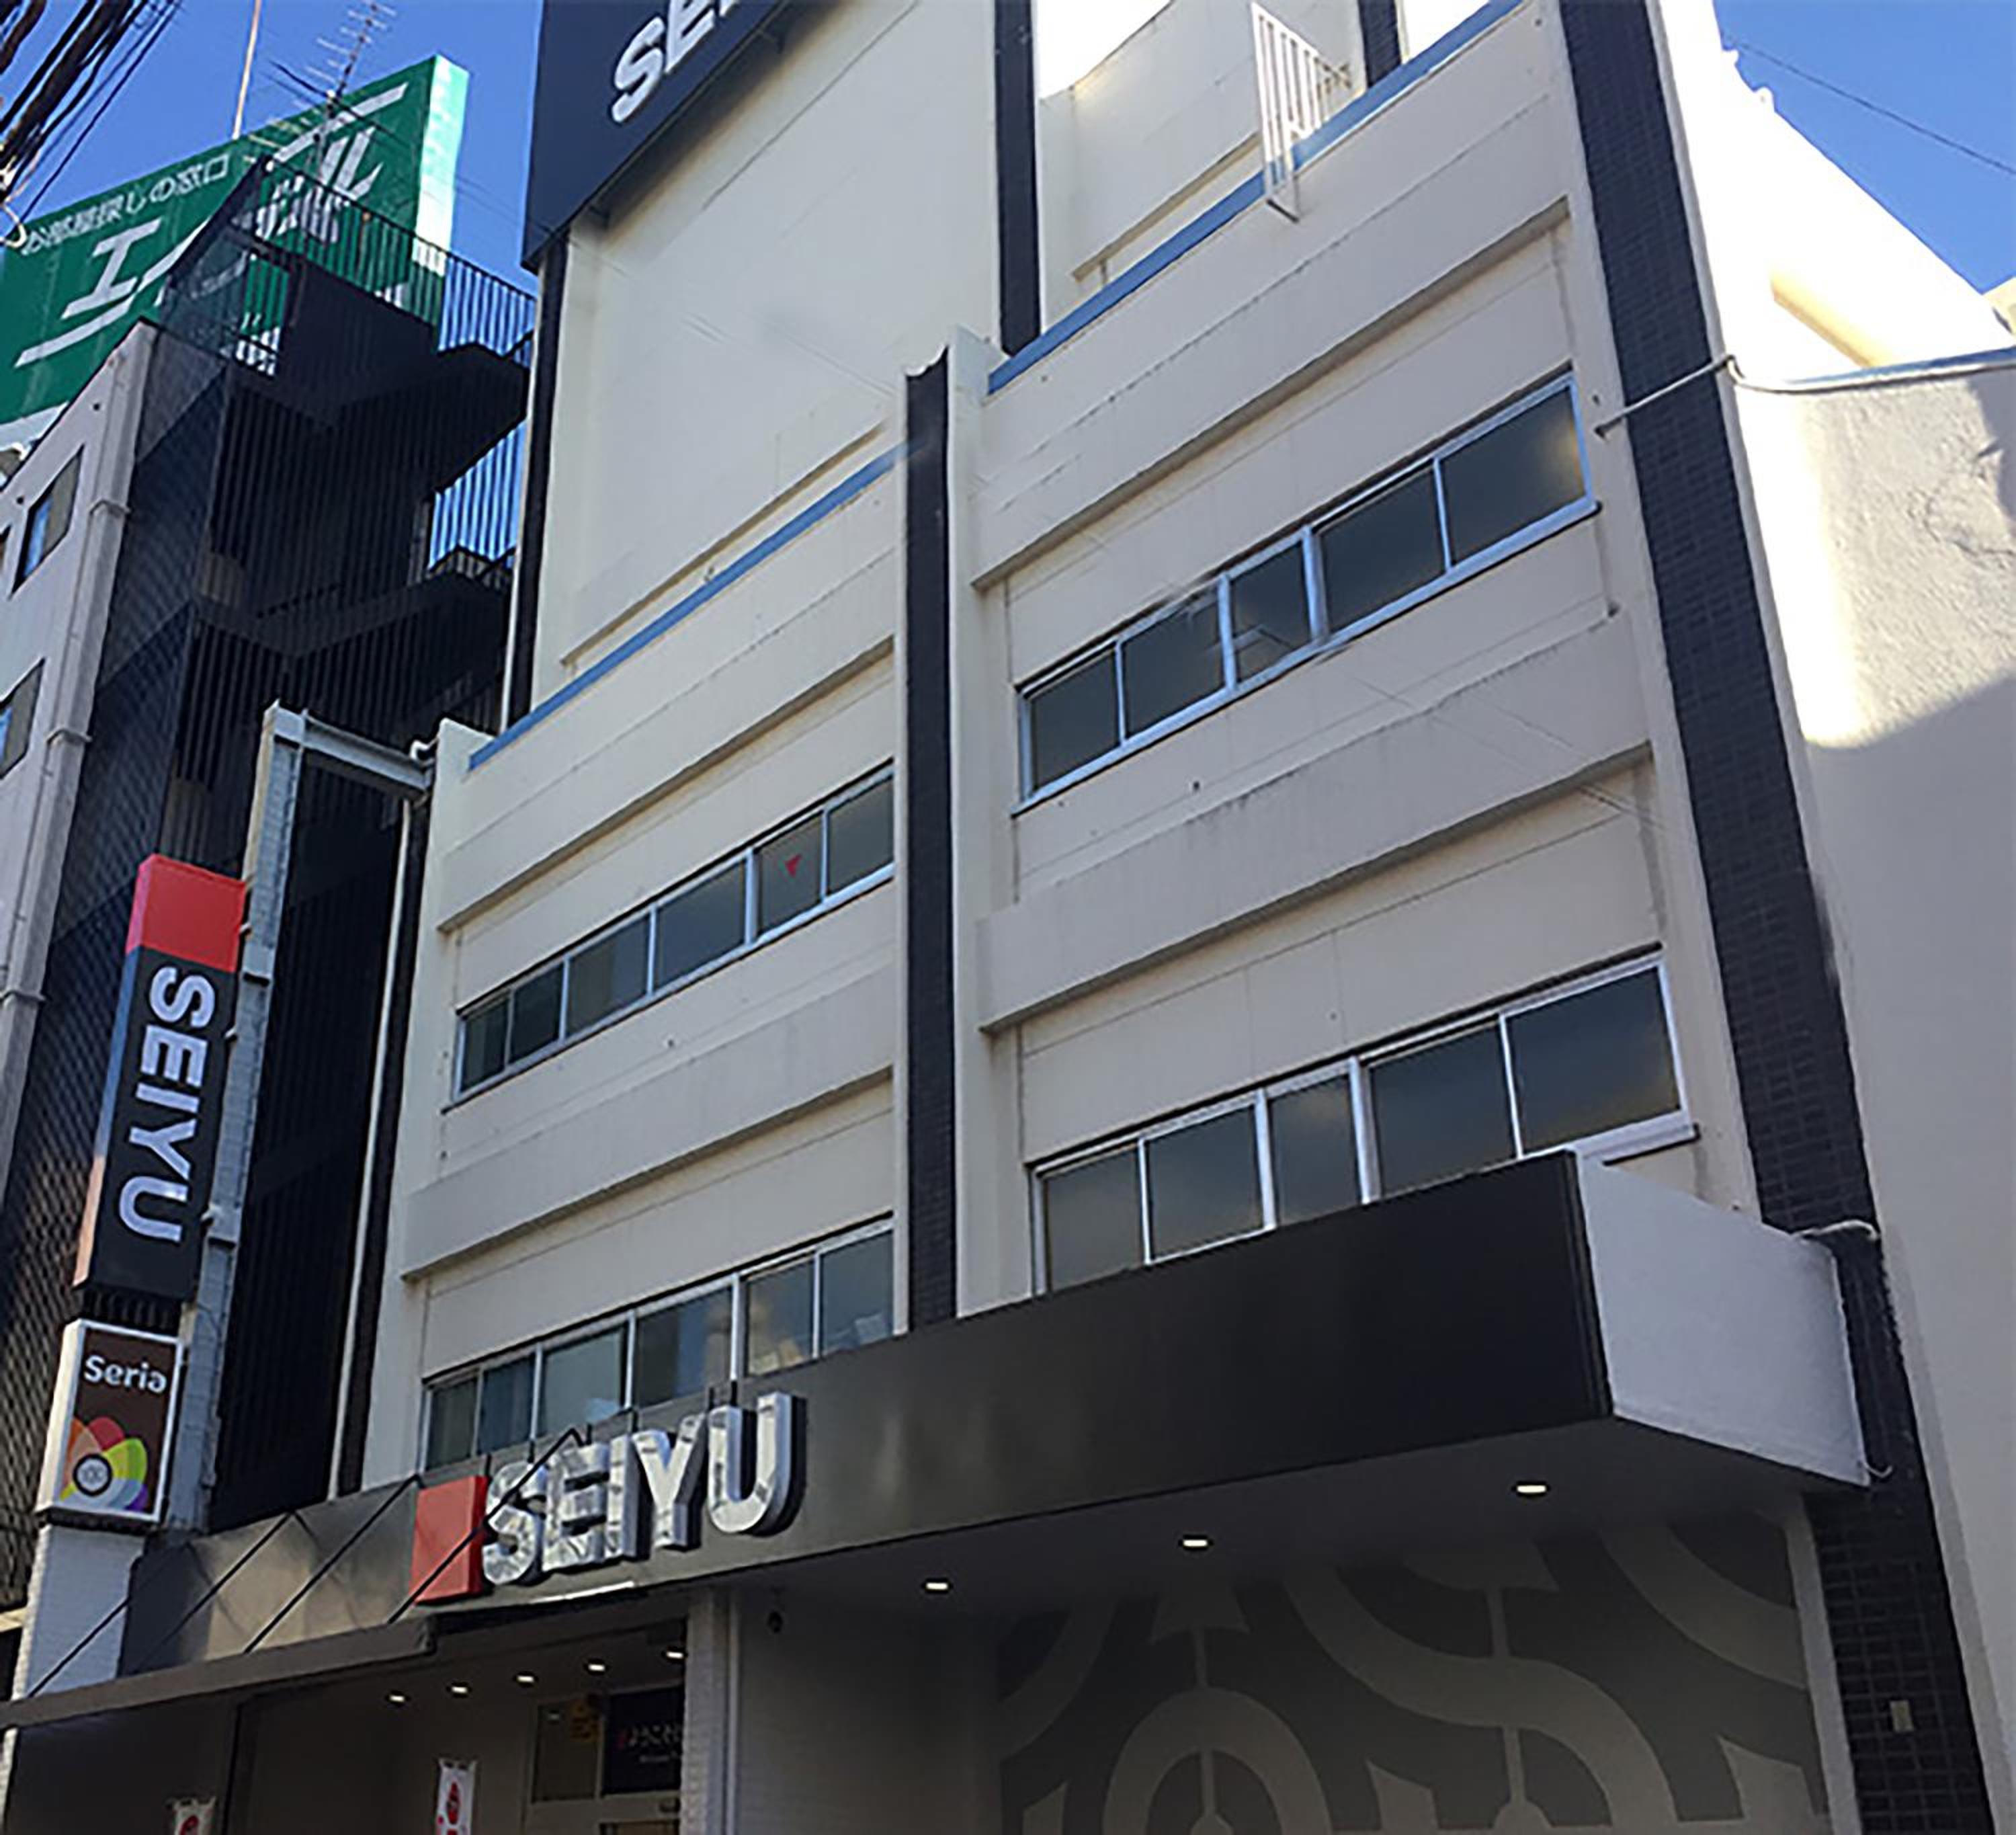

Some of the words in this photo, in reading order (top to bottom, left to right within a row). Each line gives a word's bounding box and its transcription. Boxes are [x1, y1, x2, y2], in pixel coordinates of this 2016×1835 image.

[610, 0, 738, 123] SE
[118, 965, 216, 1244] SEIYU
[83, 1354, 167, 1394] Seria
[482, 1391, 806, 1587] SEIYU
